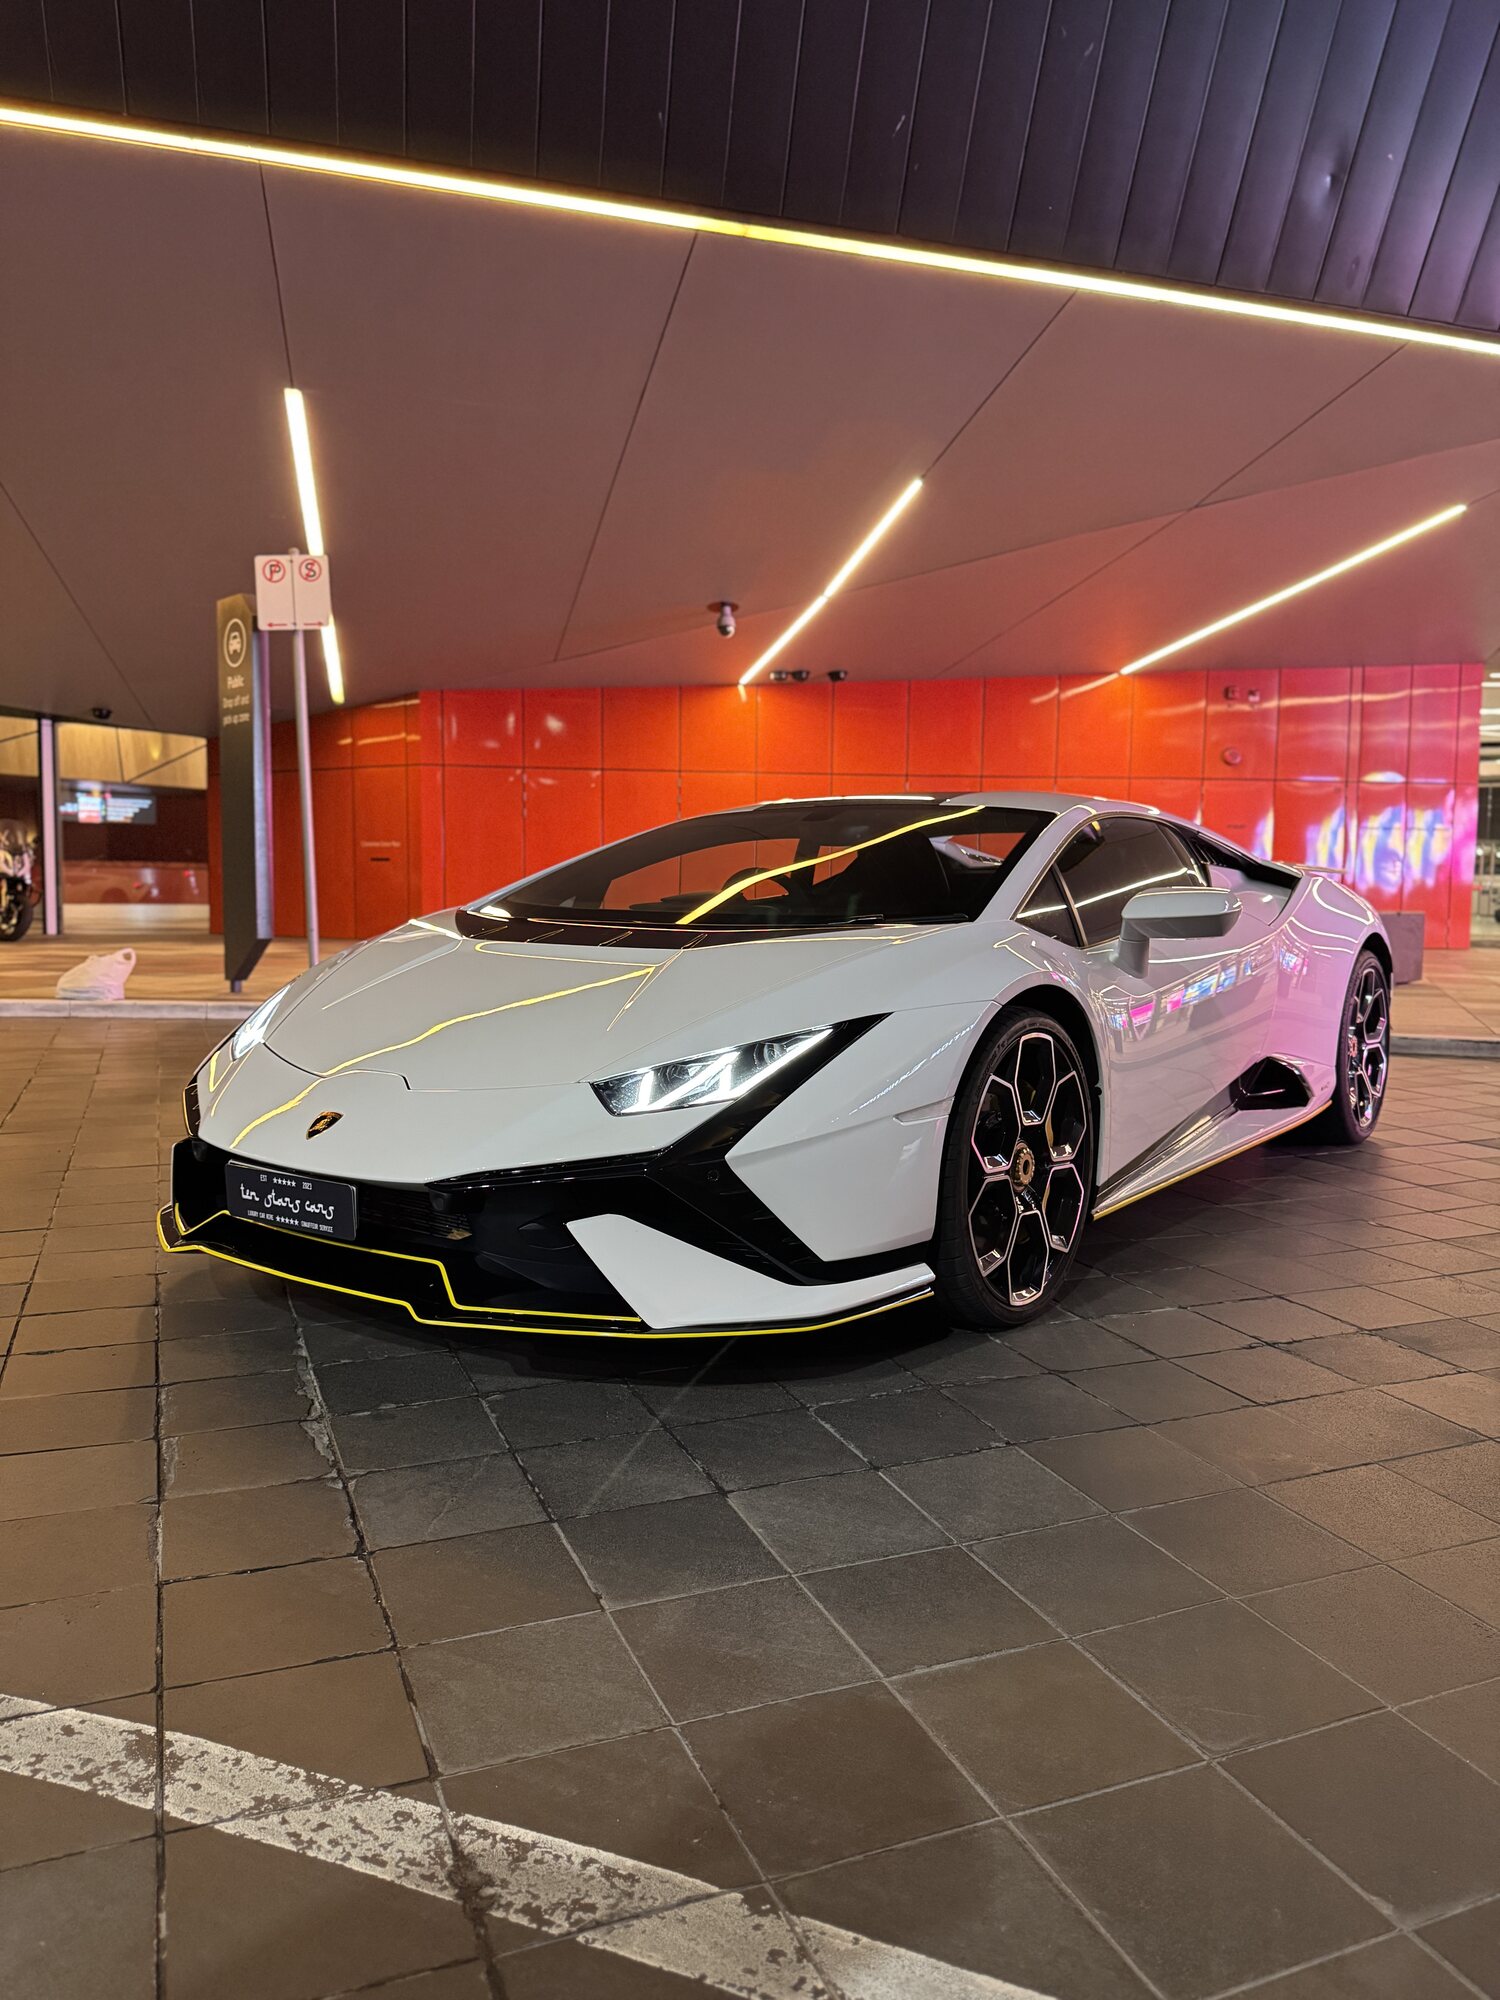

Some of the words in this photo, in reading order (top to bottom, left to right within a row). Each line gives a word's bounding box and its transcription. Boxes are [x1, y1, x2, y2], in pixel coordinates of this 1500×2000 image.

[305, 562, 317, 578] S
[240, 1183, 260, 1201] ten
[264, 1188, 301, 1213] stars
[305, 1200, 335, 1220] cars
